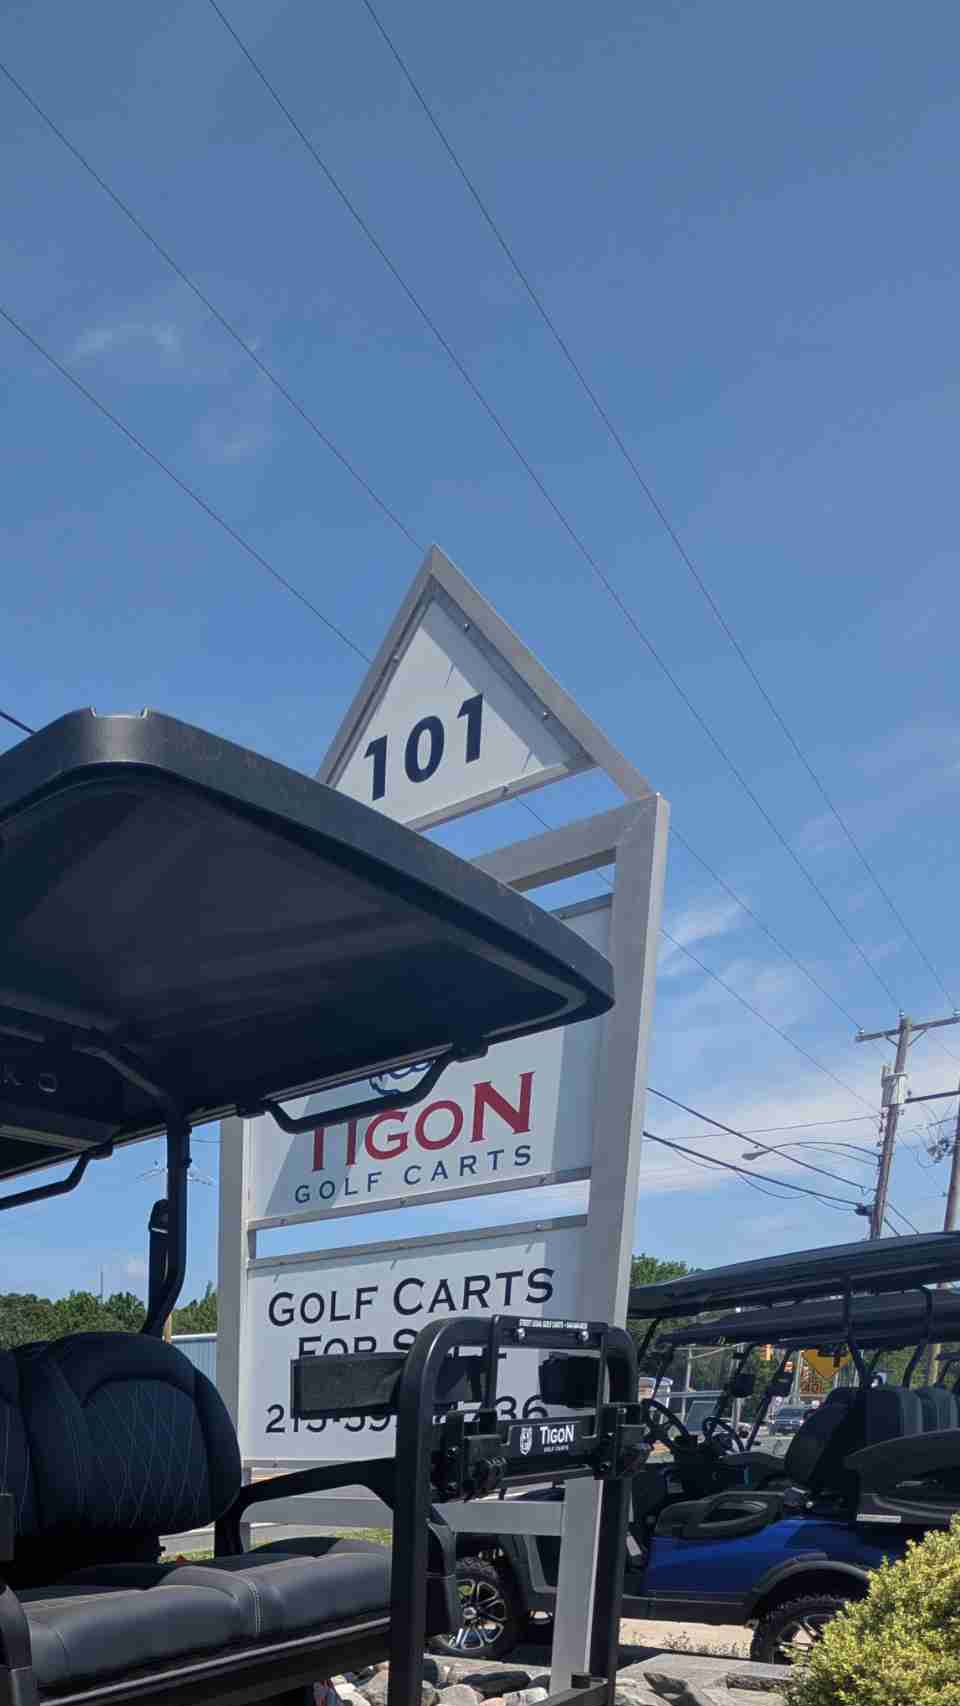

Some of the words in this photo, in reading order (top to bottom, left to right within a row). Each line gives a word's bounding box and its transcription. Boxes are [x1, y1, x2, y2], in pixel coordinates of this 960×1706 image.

[363, 692, 484, 802] 101
[294, 1171, 383, 1204] GOLF
[403, 1145, 531, 1186] CARTS
[268, 1285, 379, 1327] GOLF
[393, 1267, 555, 1317] CARTS
[539, 1424, 575, 1445] TIGON
